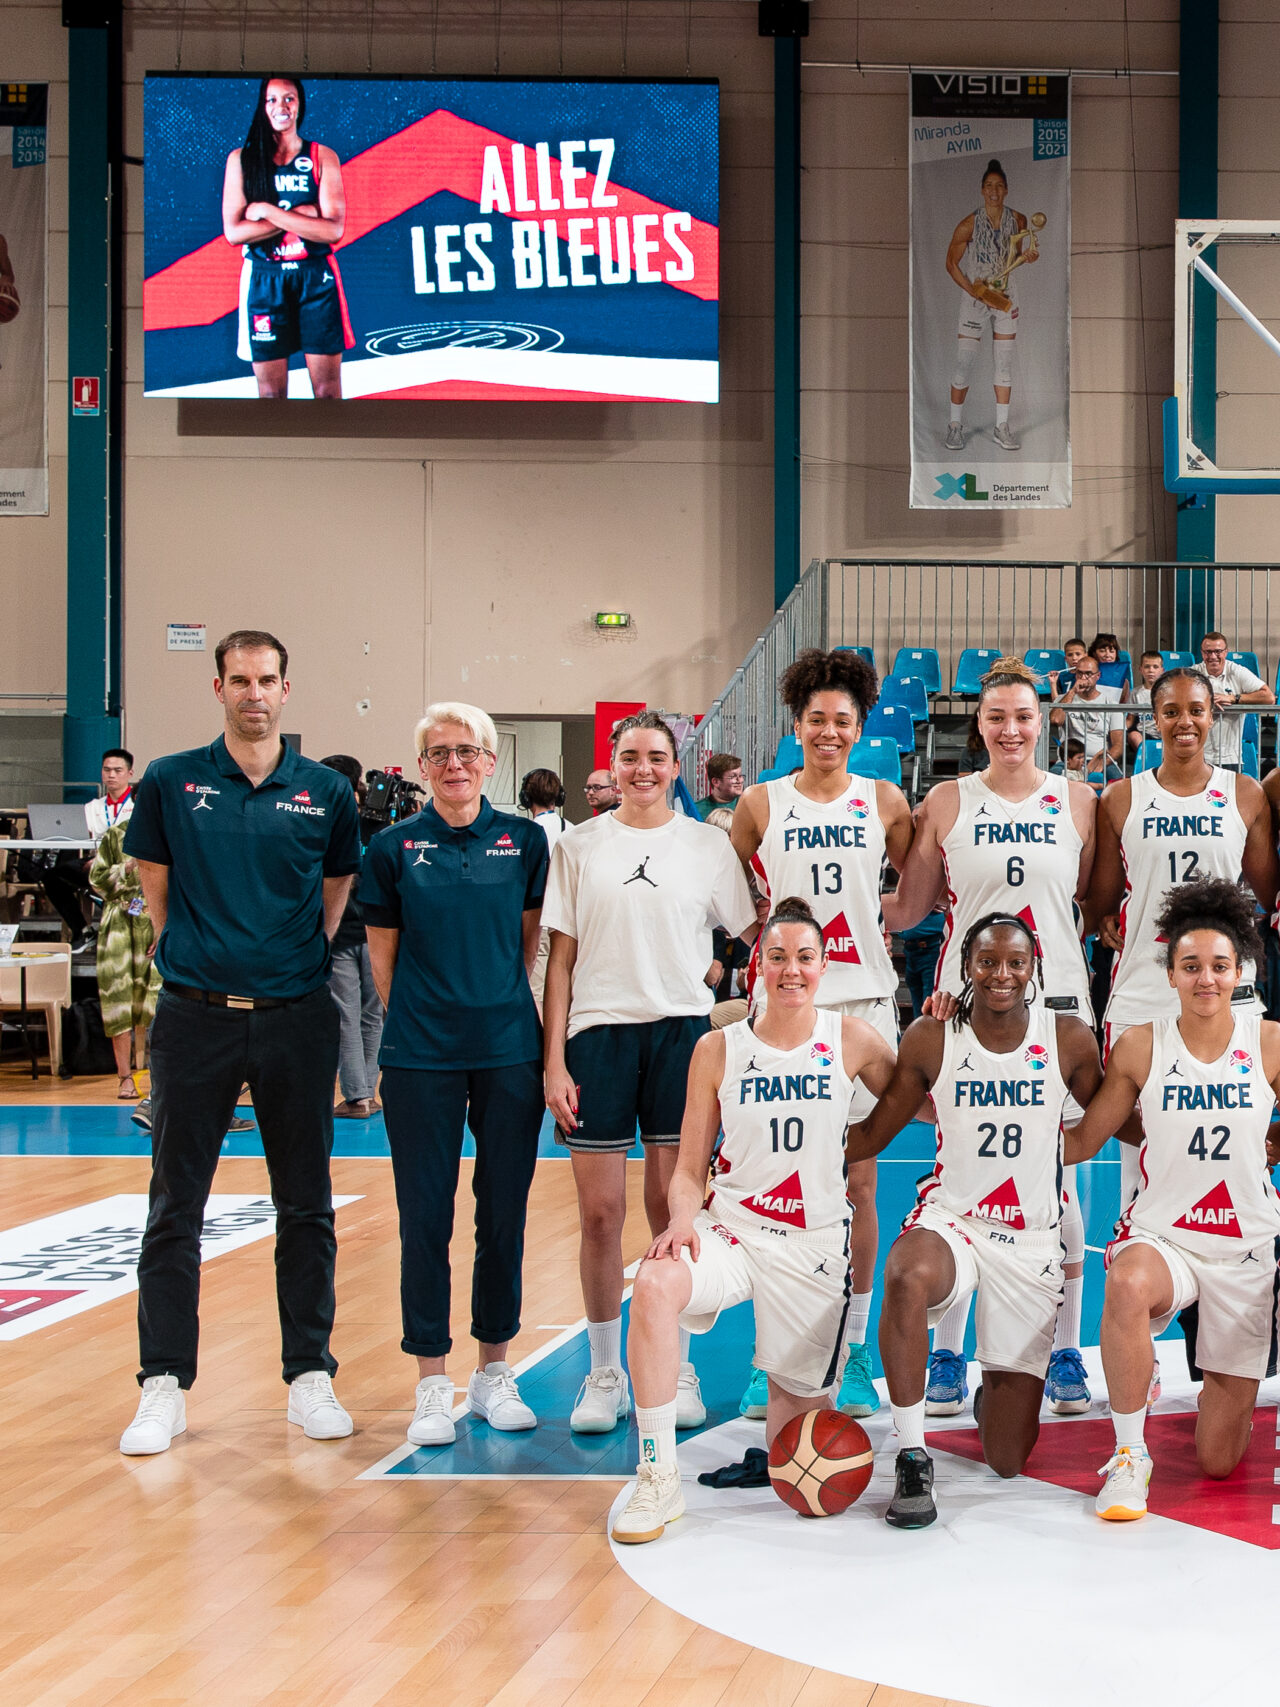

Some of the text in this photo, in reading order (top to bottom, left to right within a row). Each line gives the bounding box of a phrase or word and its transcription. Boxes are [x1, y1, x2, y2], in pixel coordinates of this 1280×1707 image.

[934, 75, 1021, 94] VISIO
[18, 136, 45, 148] 2014
[914, 121, 970, 141] Miranda
[1038, 128, 1066, 140] 2015
[18, 151, 44, 162] 2019
[946, 138, 982, 154] AYIM
[1038, 144, 1066, 155] 2021
[480, 138, 618, 214] ALLEZ
[411, 212, 694, 294] LES BLEUES
[932, 472, 988, 500] XL
[992, 484, 1049, 493] Département
[276, 802, 326, 816] FRANCE
[784, 825, 867, 852] FRANCE
[974, 822, 1056, 846] FRANCE
[1142, 816, 1224, 839] FRANCE
[486, 848, 521, 856] FRANCE
[1006, 856, 1025, 888] 6
[1168, 850, 1200, 883] 12
[810, 862, 842, 896] 13
[824, 936, 854, 952] AIF
[740, 1074, 832, 1105] FRANCE
[954, 1080, 1045, 1107] FRANCE
[1162, 1083, 1253, 1112] FRANCE
[770, 1117, 804, 1152] 10
[977, 1122, 1022, 1158] 28
[1188, 1125, 1230, 1161] 42
[752, 1193, 804, 1214] MAIF
[971, 1204, 1022, 1222] MAIF
[1184, 1208, 1236, 1225] MAIF
[989, 1232, 1015, 1244] FRA
